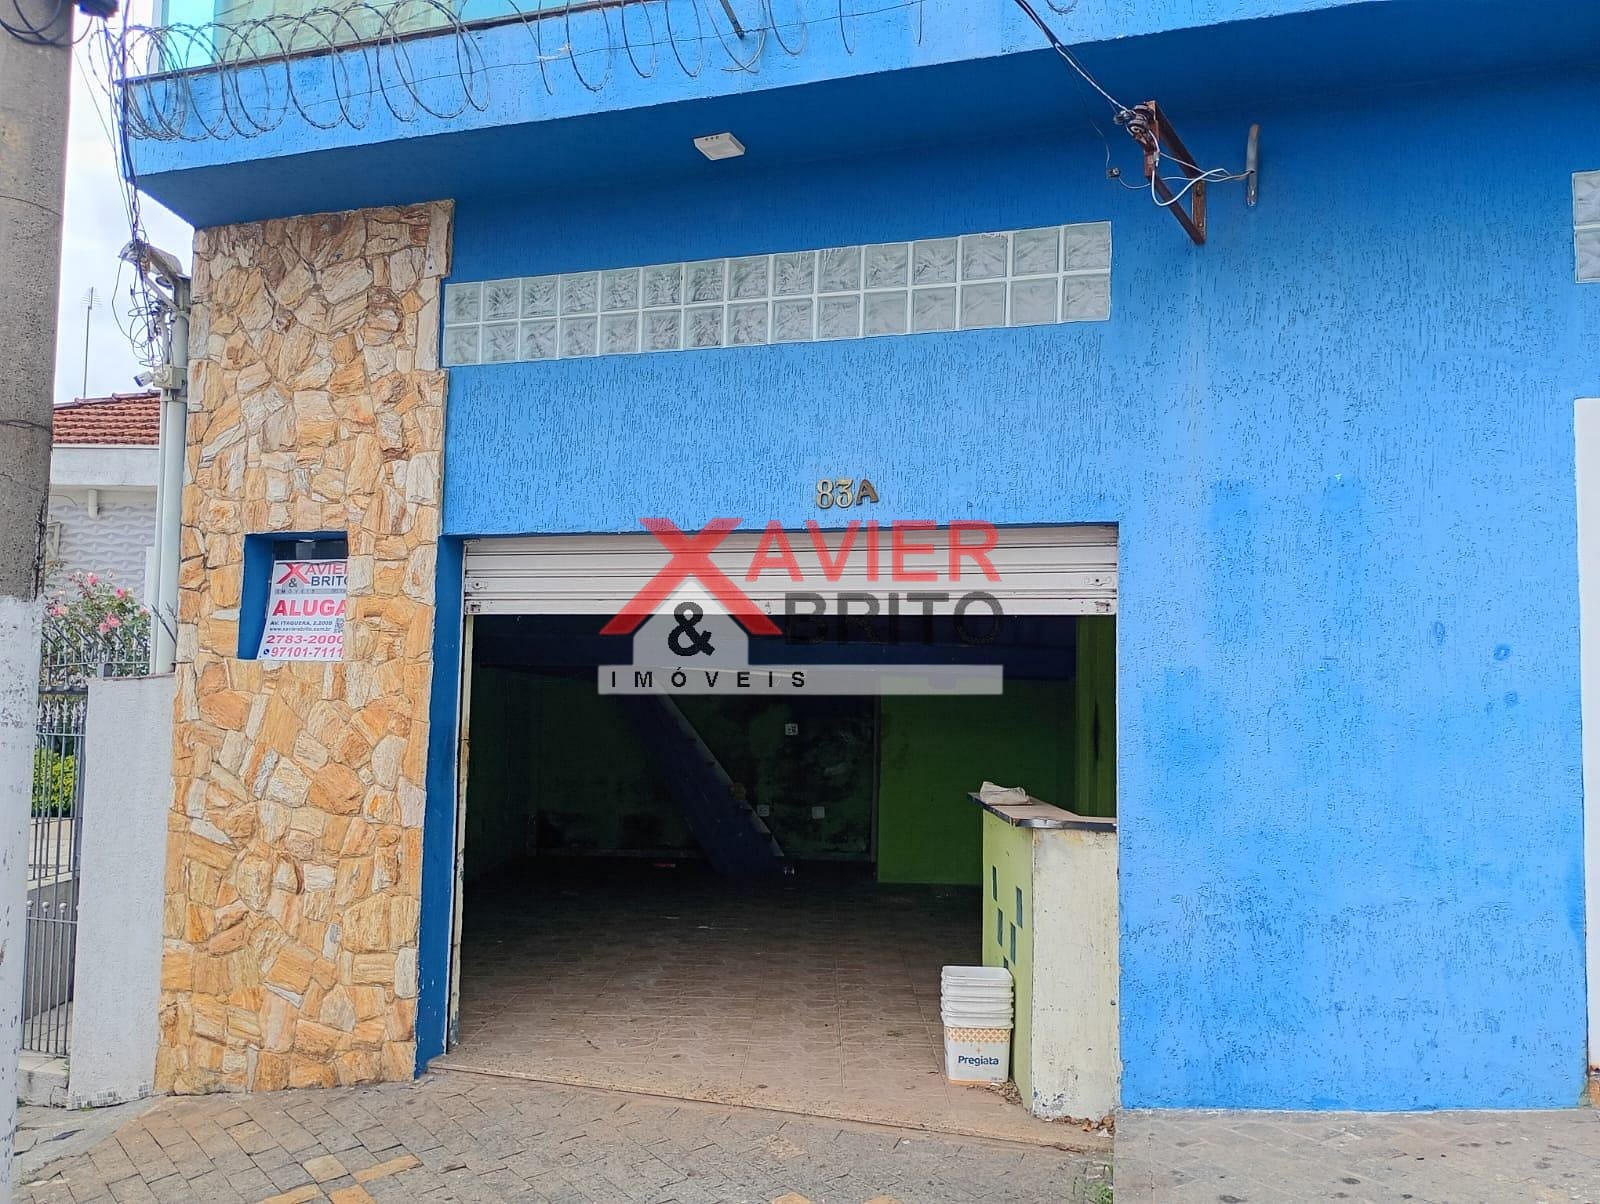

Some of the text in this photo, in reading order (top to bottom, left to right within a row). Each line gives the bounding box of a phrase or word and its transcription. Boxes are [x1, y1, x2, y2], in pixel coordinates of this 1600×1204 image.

[817, 479, 879, 509] 83A
[288, 577, 298, 588] &
[958, 1055, 999, 1067] Pregiata
